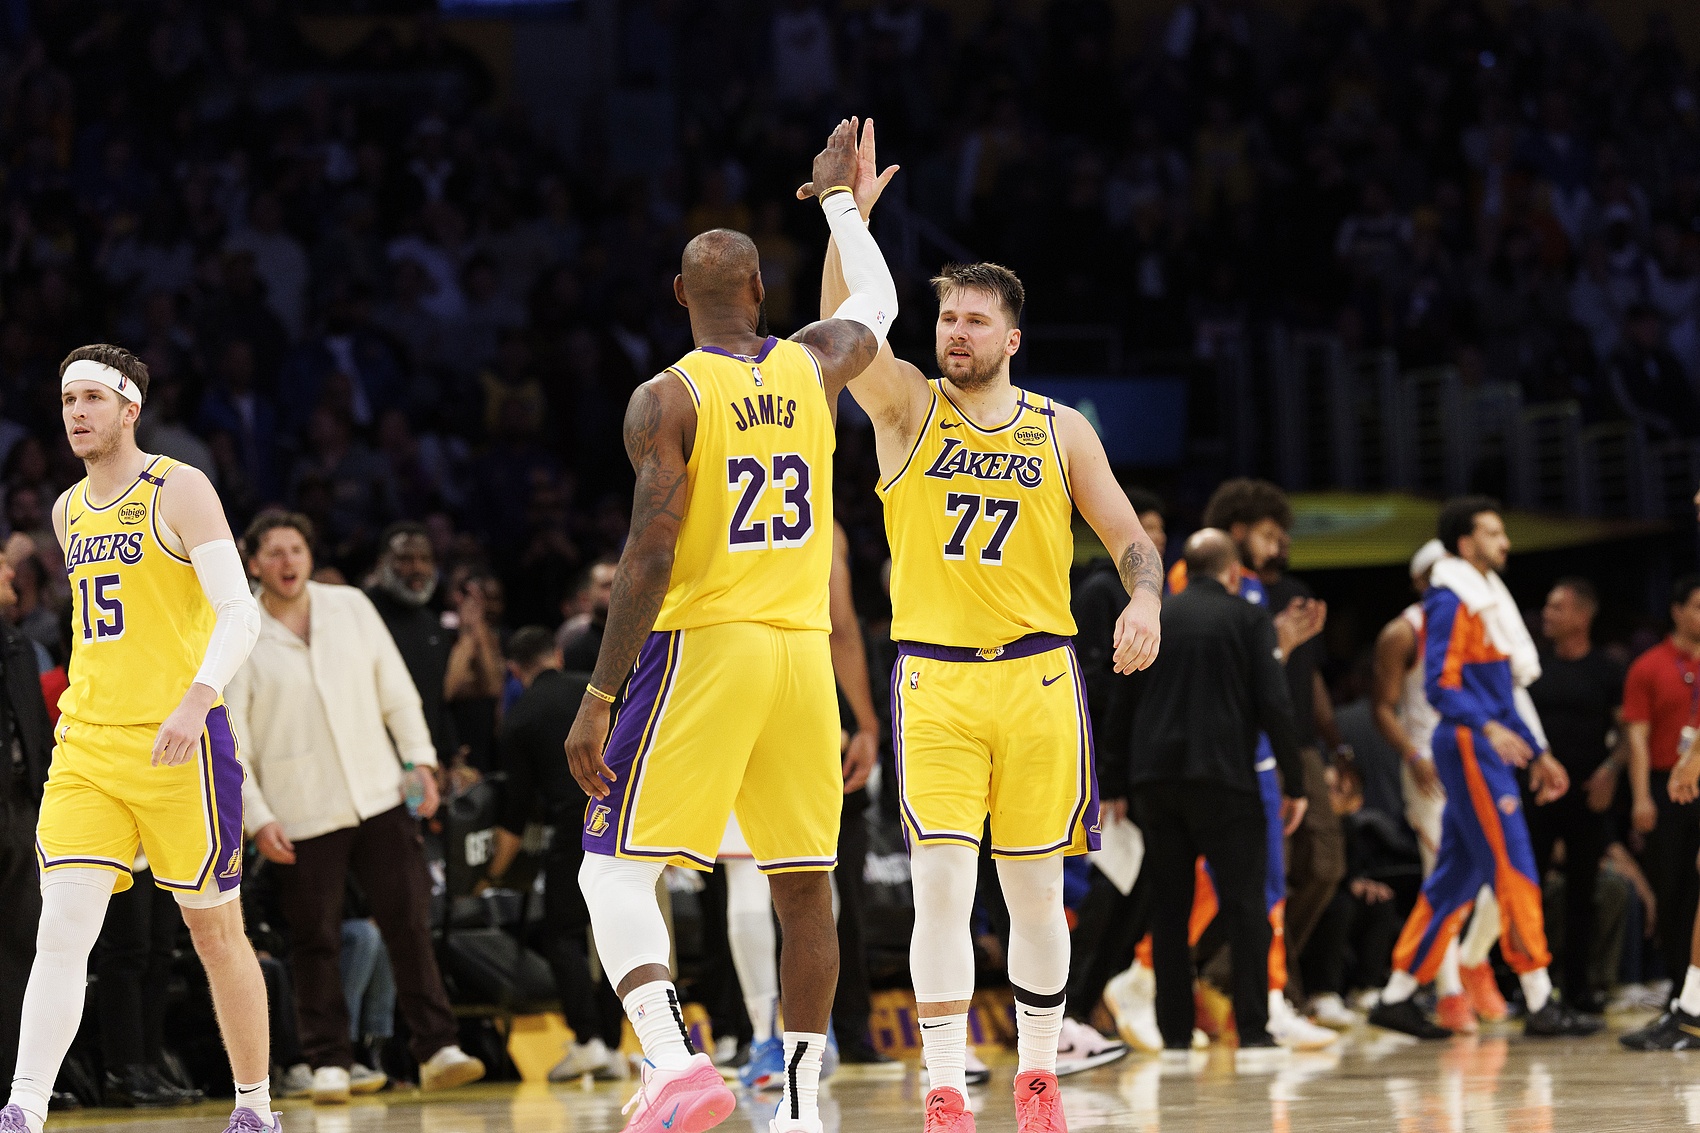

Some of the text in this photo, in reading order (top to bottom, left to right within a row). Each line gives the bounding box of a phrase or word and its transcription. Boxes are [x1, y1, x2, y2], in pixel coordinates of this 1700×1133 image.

[730, 394, 797, 432] JAMES
[1016, 430, 1045, 440] bibigo
[924, 438, 1043, 489] LAKERS
[120, 508, 145, 519] bibigo
[727, 452, 814, 553] 23
[943, 492, 1020, 566] 77
[66, 532, 145, 575] LAKERS
[79, 573, 126, 645] 15
